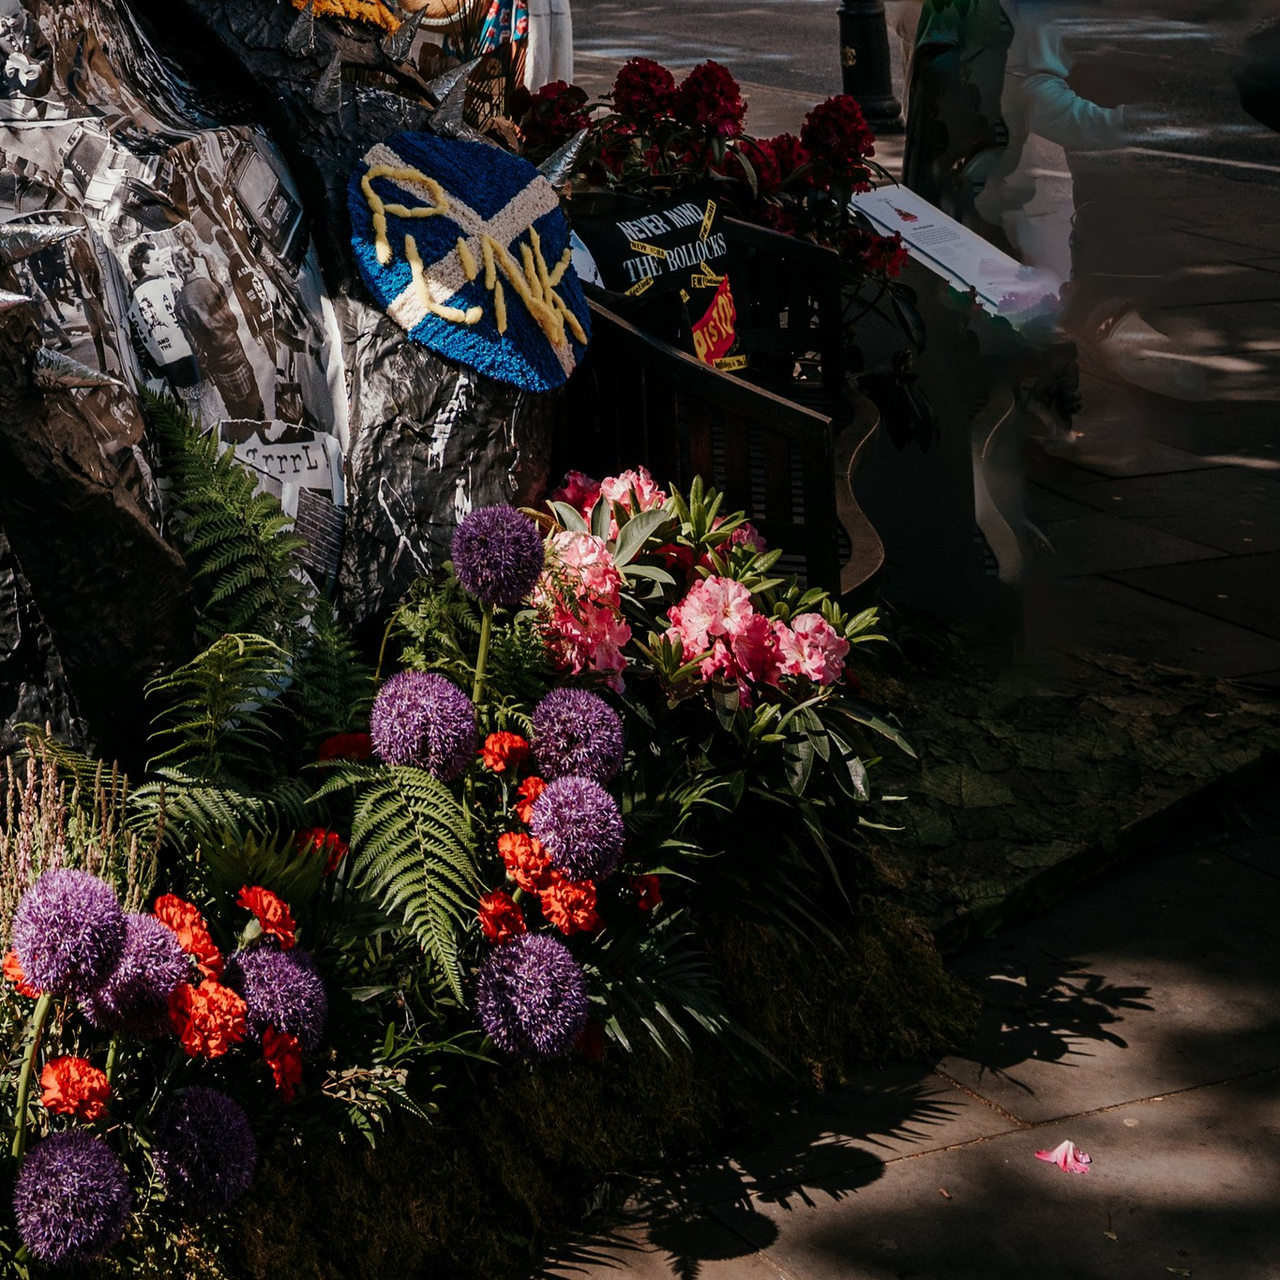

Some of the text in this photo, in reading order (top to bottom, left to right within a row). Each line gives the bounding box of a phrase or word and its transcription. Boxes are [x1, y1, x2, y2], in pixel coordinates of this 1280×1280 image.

[616, 214, 672, 242] NEVER
[663, 202, 705, 229] MIND
[361, 164, 588, 346] PUNK
[623, 254, 662, 283] THE
[665, 233, 727, 272] BOLLOCKS
[631, 241, 666, 258] NEW YORK
[157, 337, 170, 347] AND
